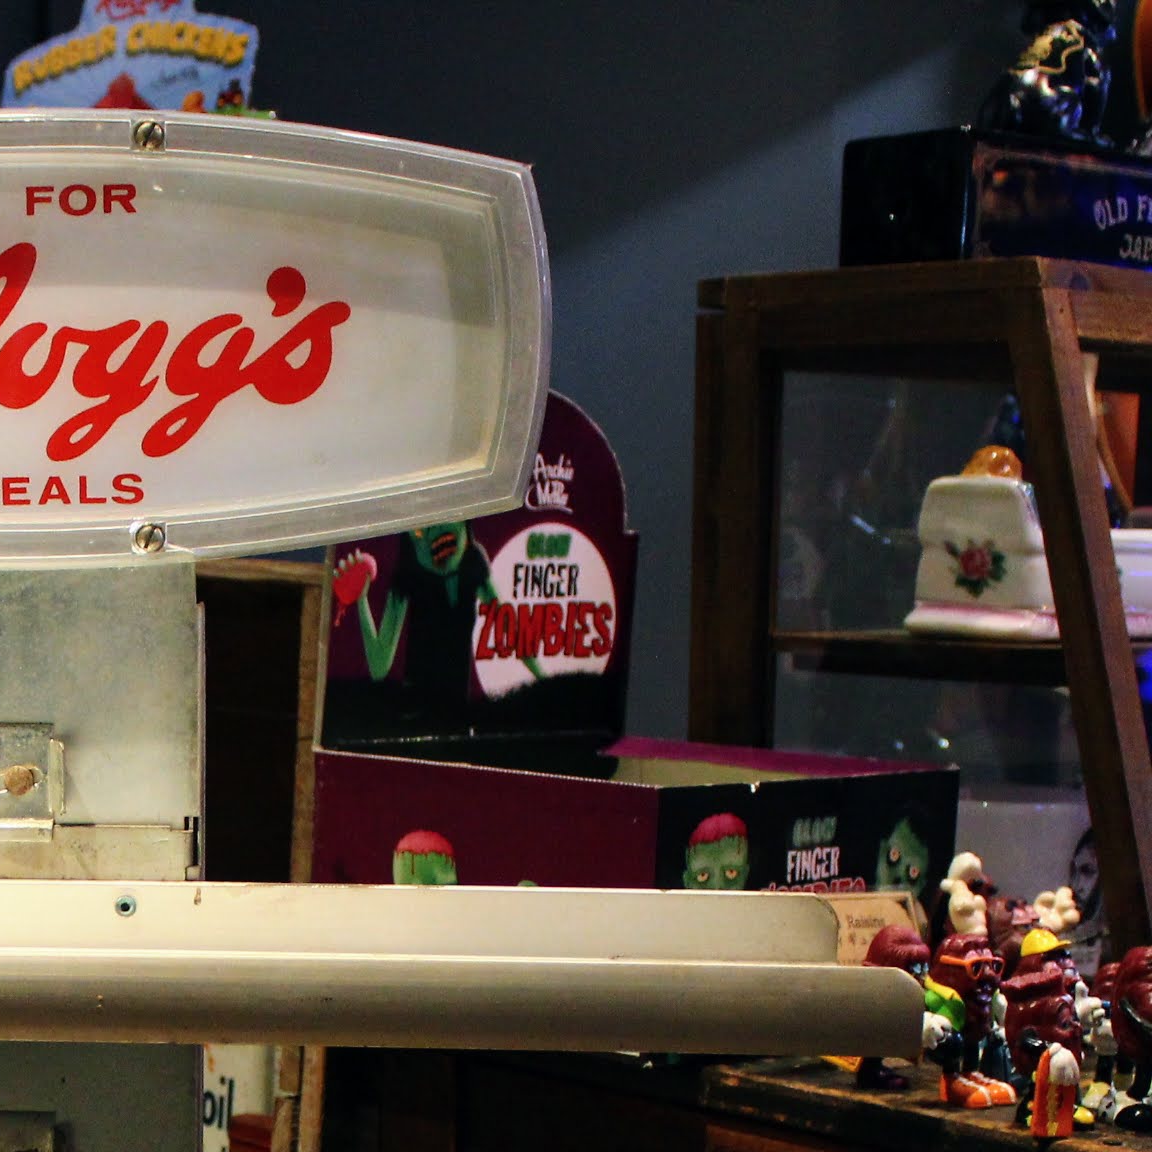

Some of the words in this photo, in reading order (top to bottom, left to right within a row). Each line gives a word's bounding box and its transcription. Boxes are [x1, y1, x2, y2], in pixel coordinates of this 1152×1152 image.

[13, 25, 117, 97] RUBBER
[26, 184, 137, 216] FOR
[1093, 197, 1128, 231] OLD
[512, 563, 580, 599] FINGER
[476, 600, 613, 660] ZOMBIES
[786, 847, 841, 884] FINGER
